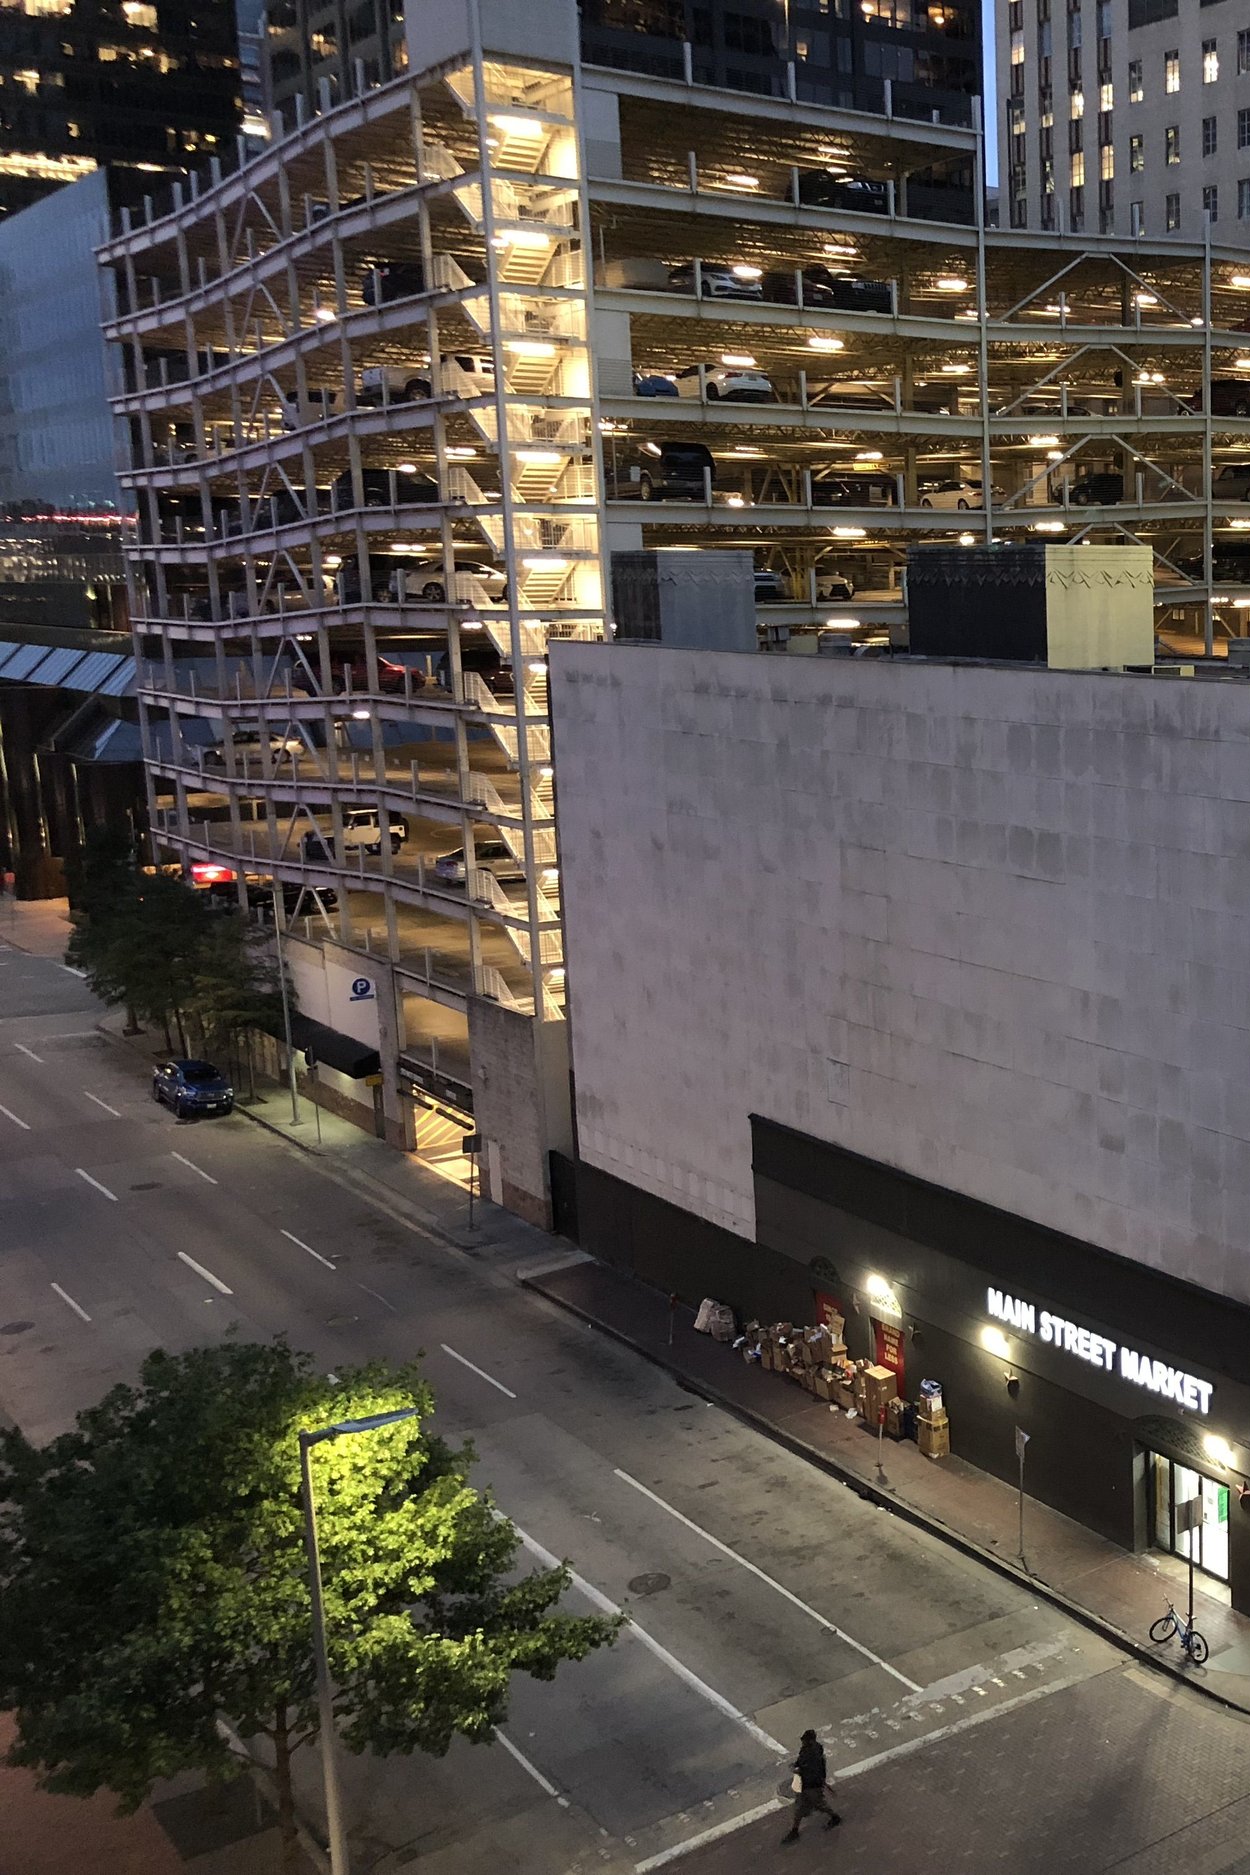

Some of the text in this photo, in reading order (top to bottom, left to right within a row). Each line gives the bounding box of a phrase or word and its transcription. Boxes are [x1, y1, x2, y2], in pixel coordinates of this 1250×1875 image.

[886, 1344, 897, 1355] FOR
[986, 1286, 1214, 1415] MAIN STREET MARKET
[885, 1351, 898, 1364] LESS
